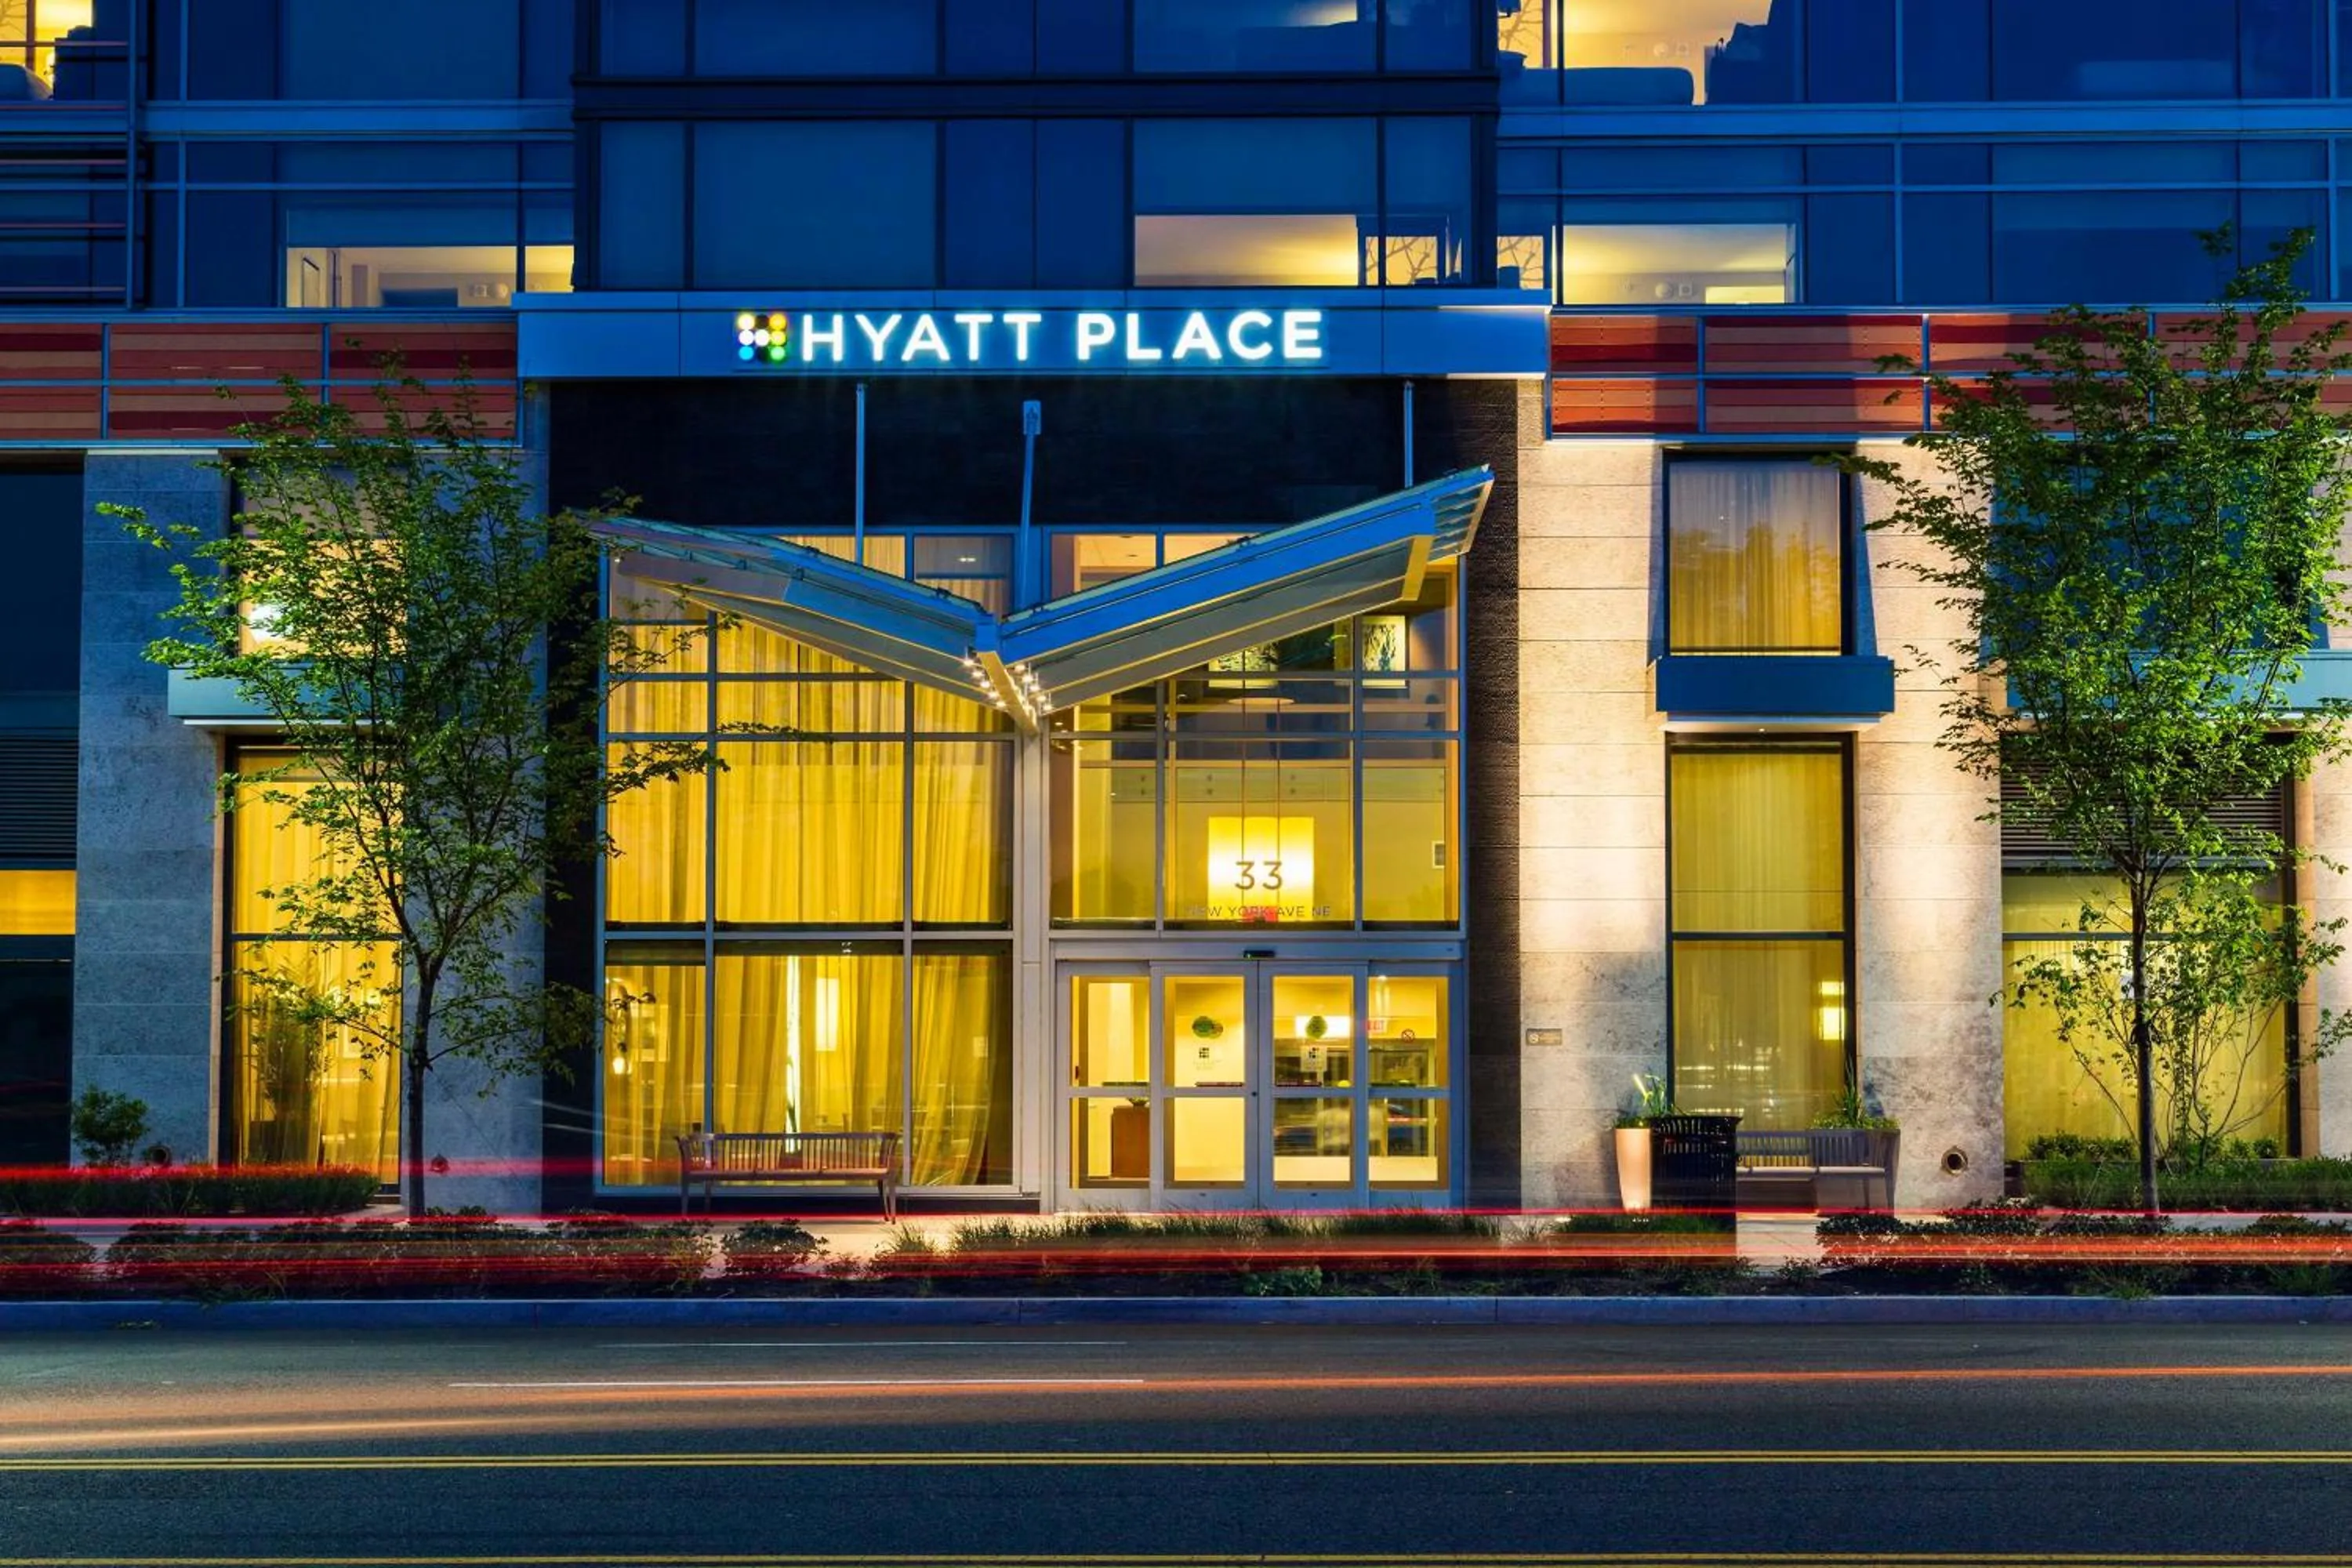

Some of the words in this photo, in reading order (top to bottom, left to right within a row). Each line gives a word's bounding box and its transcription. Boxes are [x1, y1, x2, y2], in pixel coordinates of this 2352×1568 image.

[801, 313, 1043, 362] HYATT
[1076, 310, 1323, 361] PLACE
[1234, 861, 1283, 891] 33
[1228, 905, 1269, 916] YORK
[1277, 905, 1305, 916] AVE
[1312, 905, 1331, 916] NE
